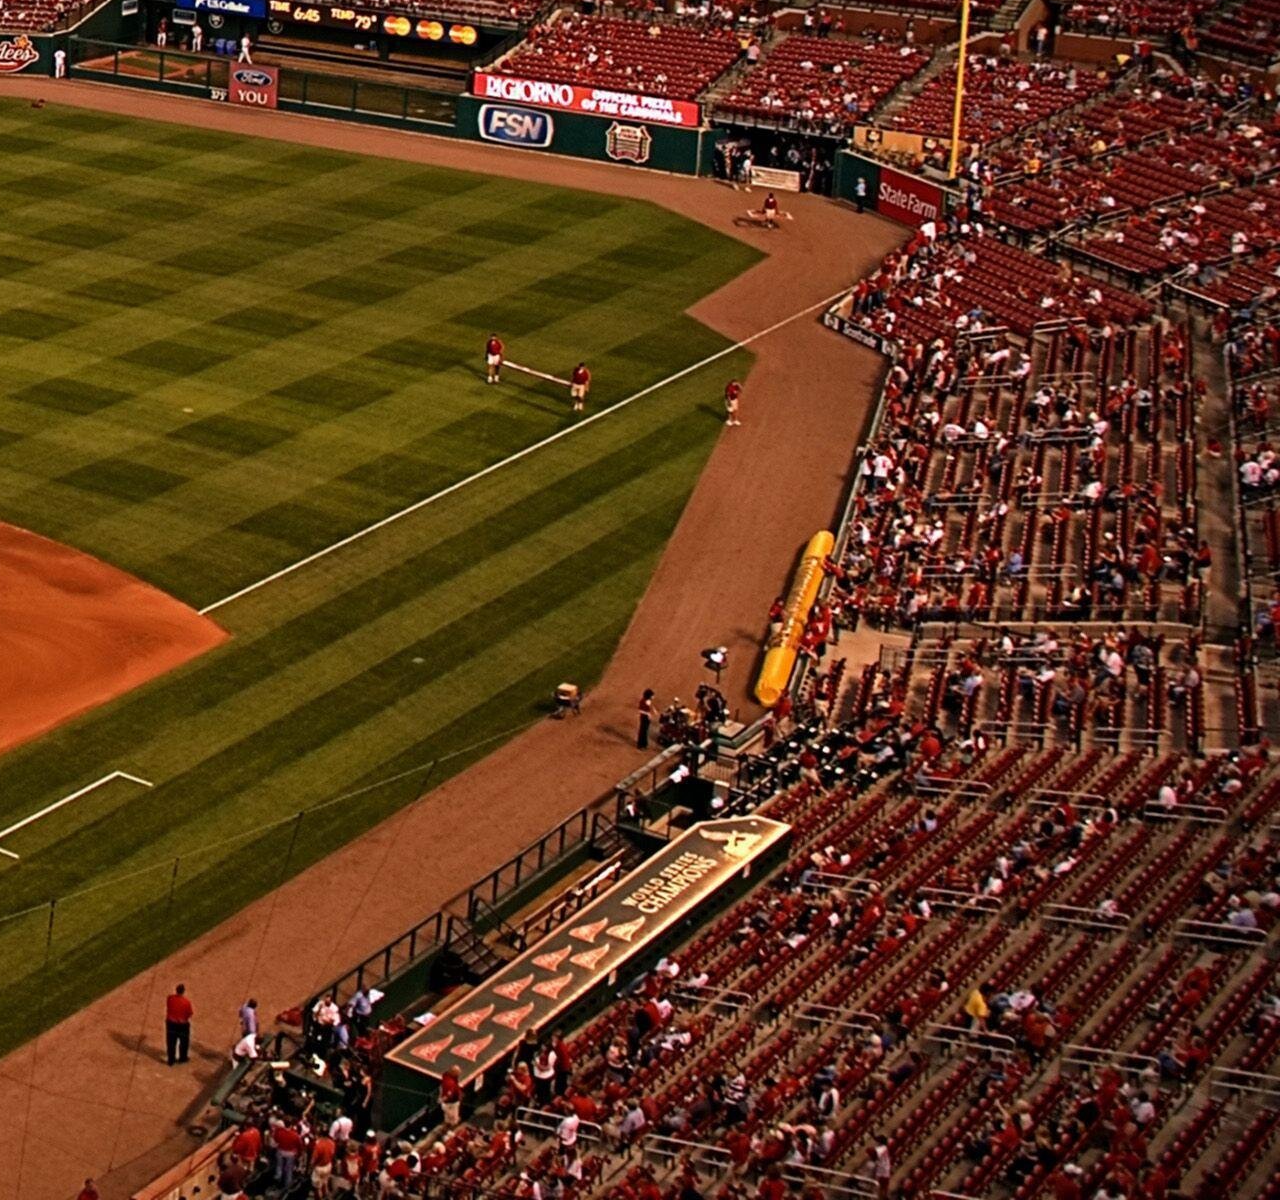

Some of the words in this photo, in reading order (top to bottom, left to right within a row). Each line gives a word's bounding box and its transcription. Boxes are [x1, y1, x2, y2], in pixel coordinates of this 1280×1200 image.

[270, 0, 290, 12] TIME
[330, 8, 355, 20] TEMP
[240, 71, 266, 85] Ford
[237, 89, 268, 104] YOU
[489, 111, 542, 140] FSN
[878, 181, 908, 208] State
[905, 192, 938, 219] Farm
[621, 877, 665, 907] WORLD
[659, 852, 698, 880] SERIES
[638, 856, 718, 914] CHAMPIONS
